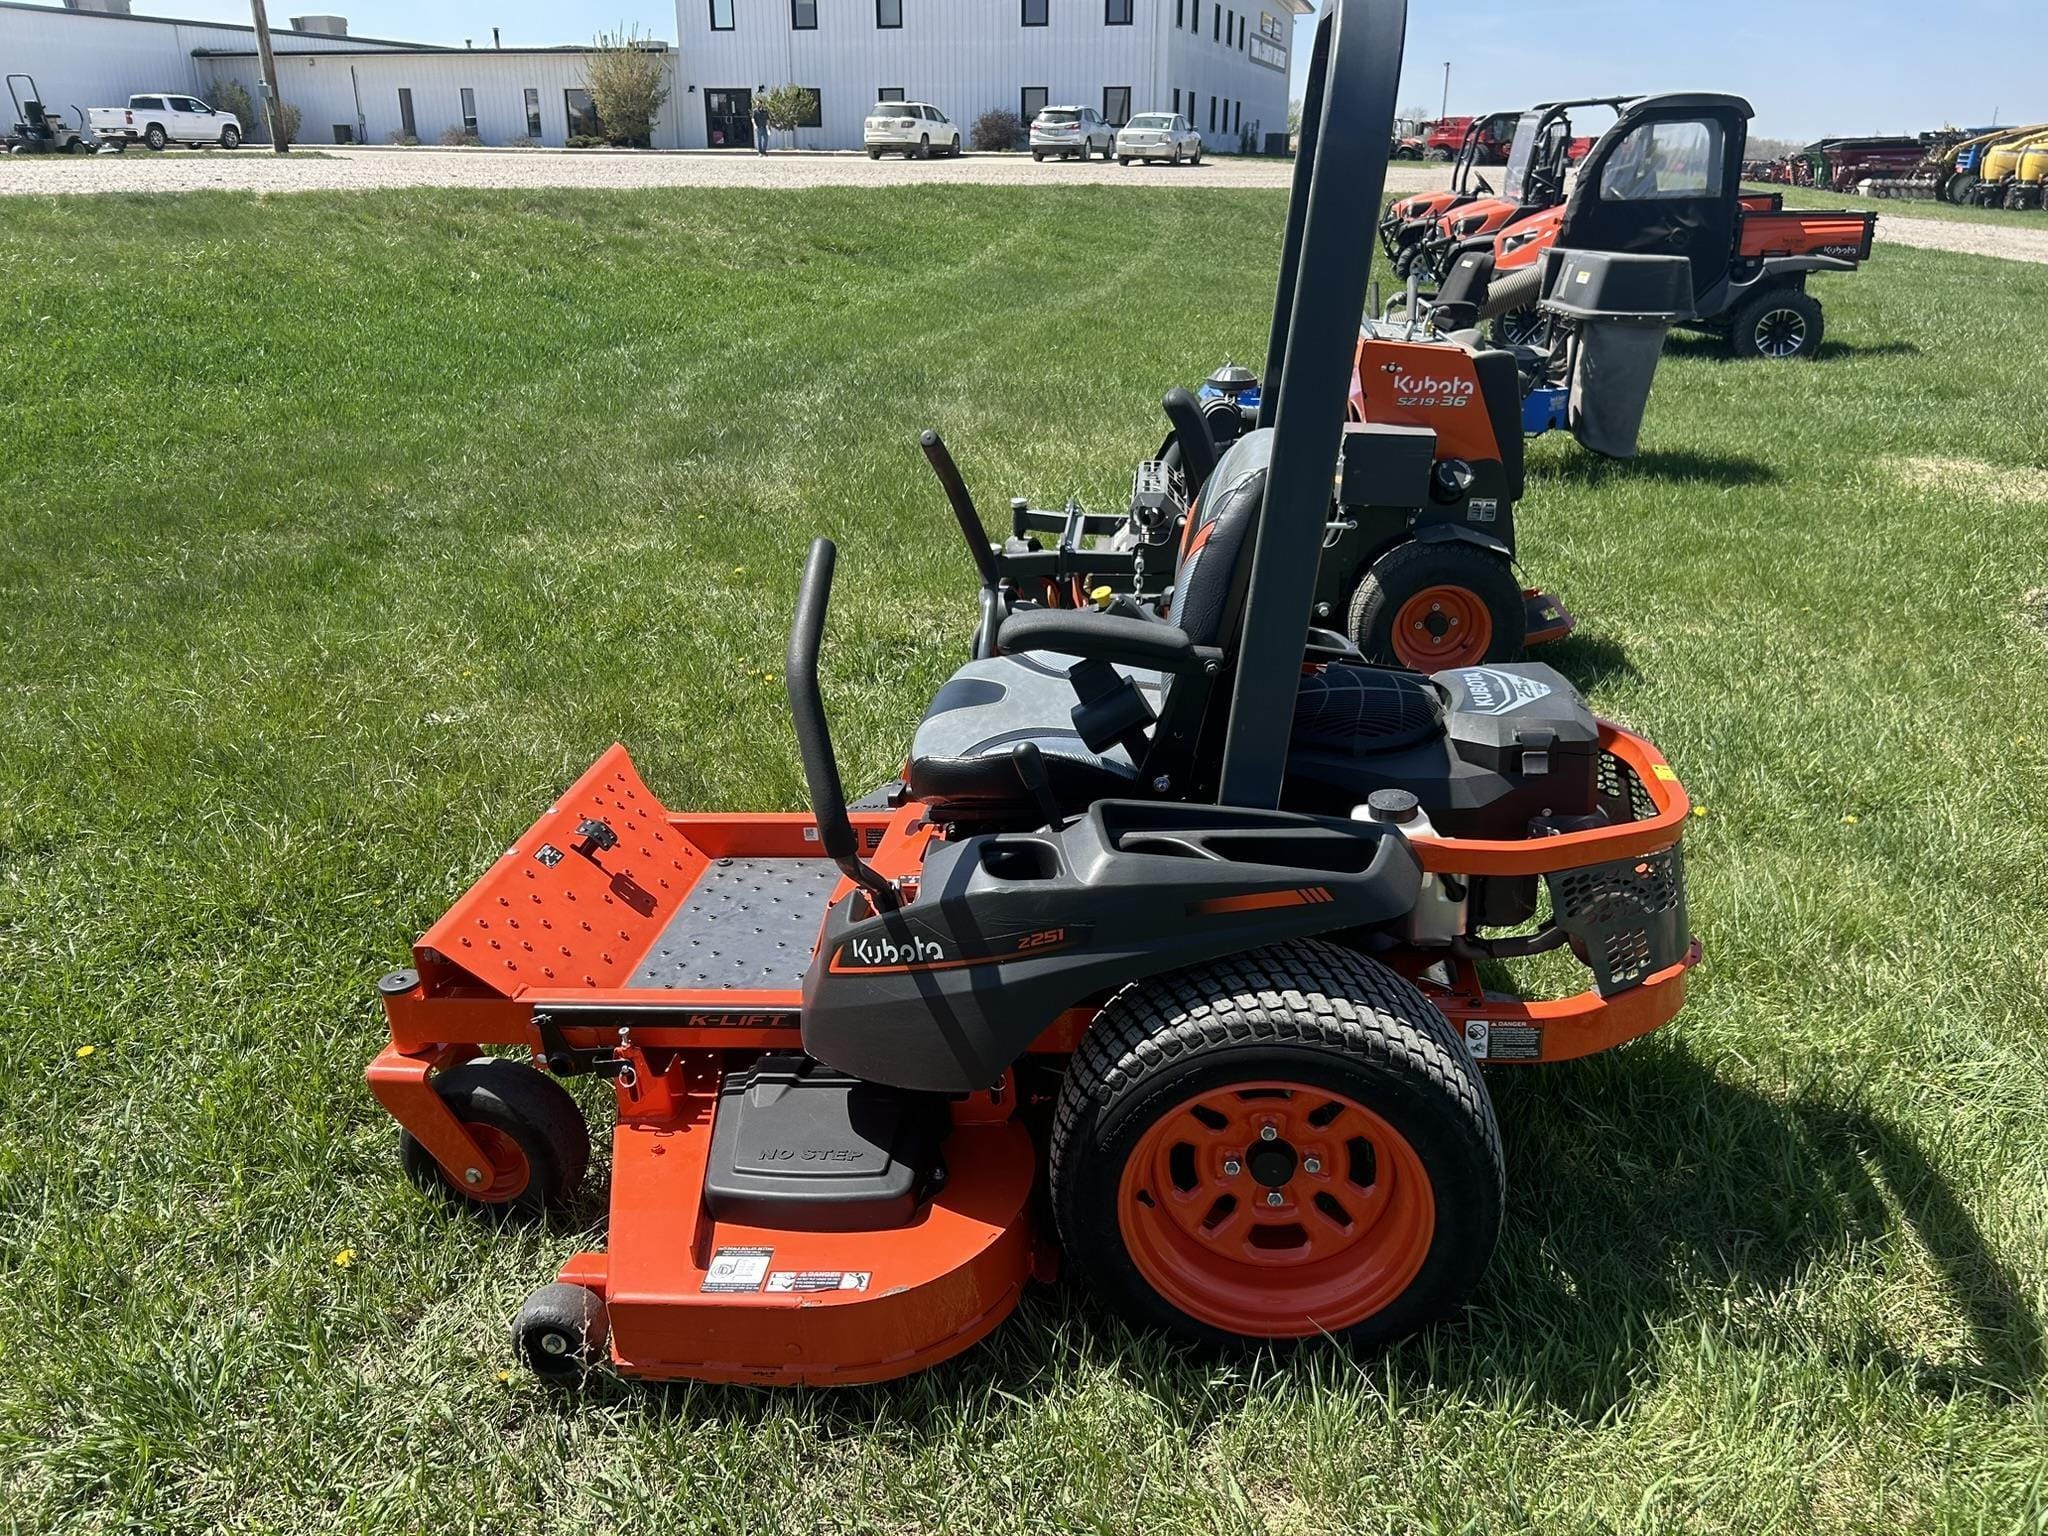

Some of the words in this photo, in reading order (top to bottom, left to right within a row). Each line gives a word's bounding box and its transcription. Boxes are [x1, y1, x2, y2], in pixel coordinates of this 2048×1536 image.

[1823, 246, 1857, 254] Kubota
[1394, 375, 1474, 394] Kubota
[1463, 672, 1495, 707] KUBOTA
[852, 935, 944, 964] Kubota
[688, 1015, 787, 1026] K-LIFT
[758, 1149, 795, 1161] NO
[799, 1149, 864, 1162] STEP
